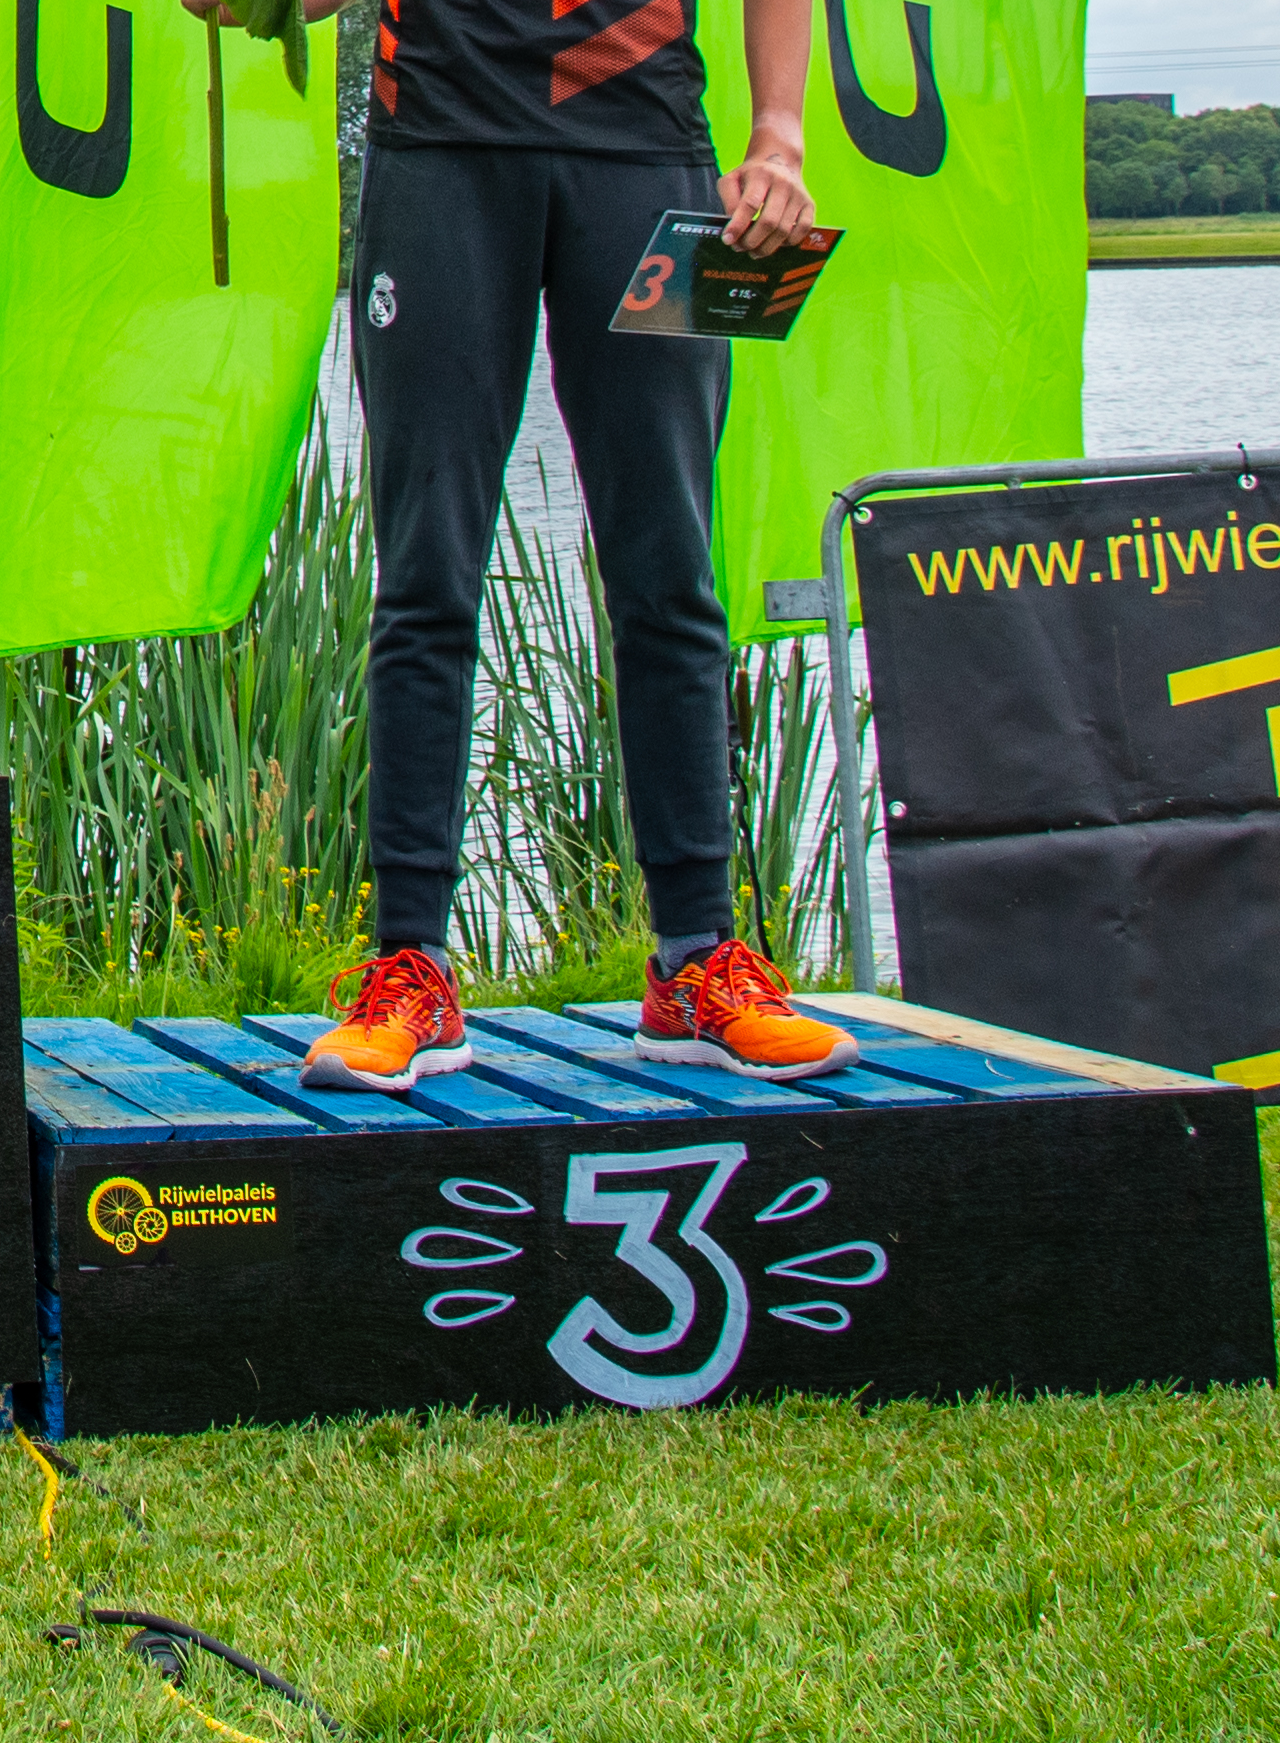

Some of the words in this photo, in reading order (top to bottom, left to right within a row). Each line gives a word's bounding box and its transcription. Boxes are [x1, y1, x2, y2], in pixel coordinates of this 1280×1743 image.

[622, 254, 676, 312] 3
[907, 509, 1280, 596] www.rijwie
[158, 1182, 276, 1206] Rijwielpaleis
[171, 1206, 278, 1227] BILTHOVEN
[546, 1142, 748, 1409] 3
